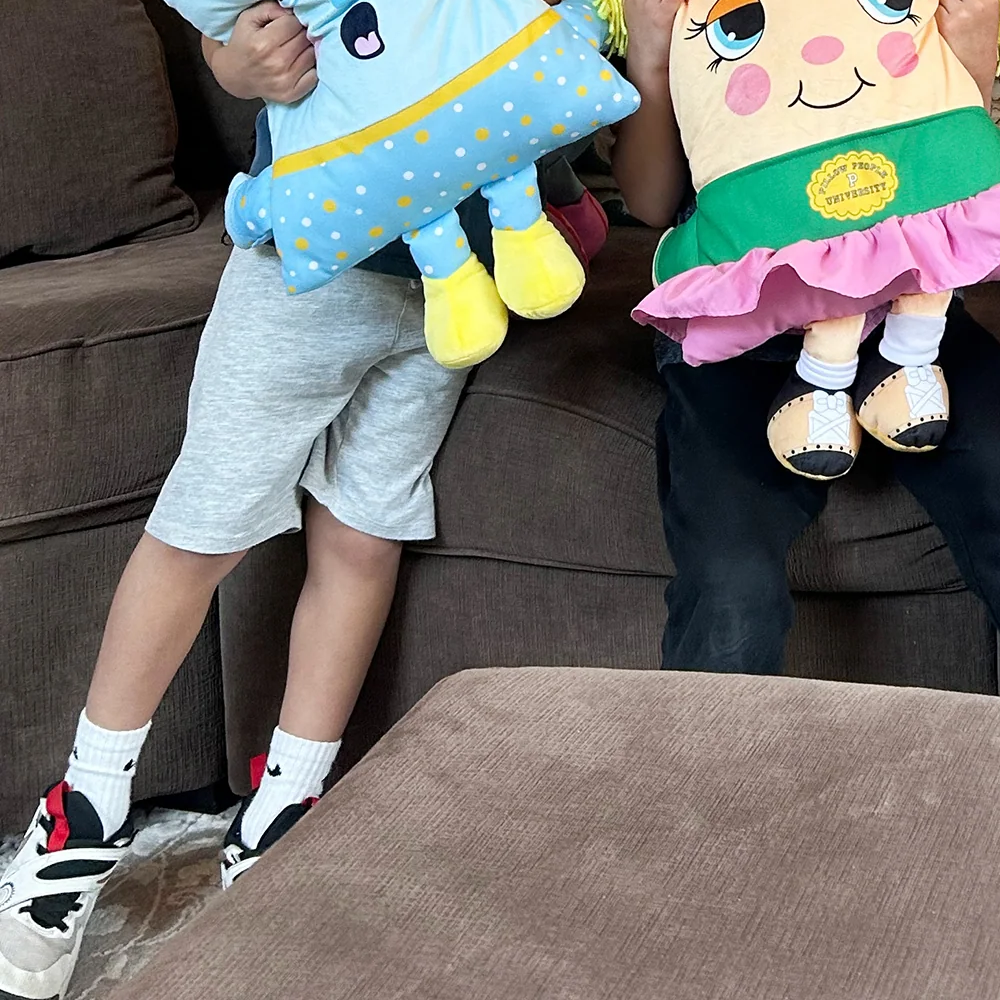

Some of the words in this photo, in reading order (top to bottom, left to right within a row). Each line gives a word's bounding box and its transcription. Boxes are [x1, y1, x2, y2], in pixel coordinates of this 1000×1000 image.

[818, 164, 848, 195] PILLOW
[851, 162, 888, 179] PEOPLE
[846, 172, 858, 188] P
[825, 182, 887, 206] UNIVERSITY
